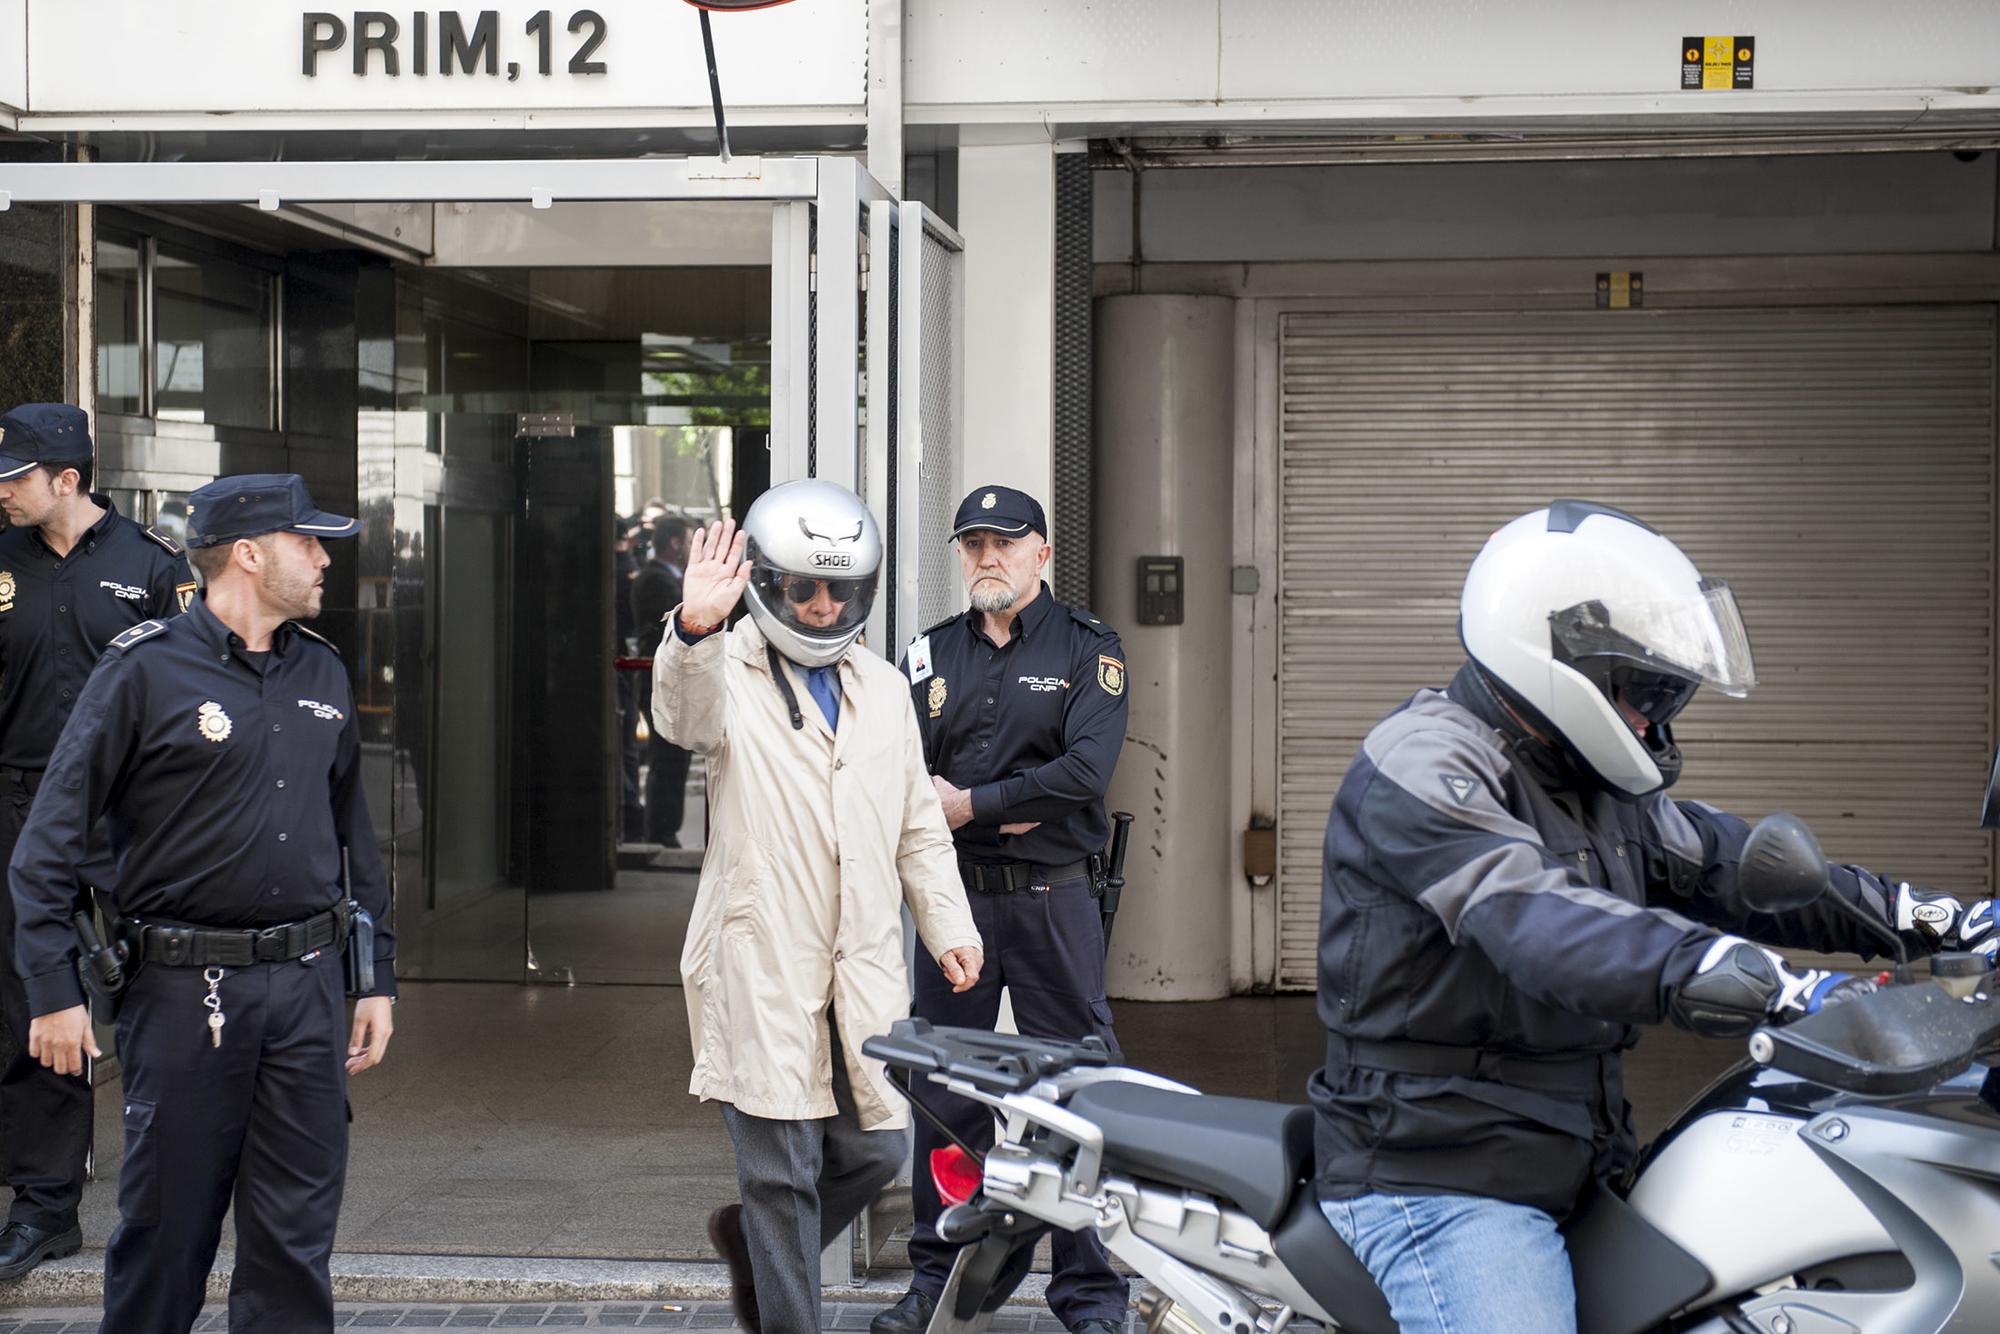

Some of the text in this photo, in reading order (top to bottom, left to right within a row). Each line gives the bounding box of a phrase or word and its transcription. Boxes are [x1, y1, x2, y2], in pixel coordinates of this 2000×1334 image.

[302, 9, 607, 81] PRIM,12
[815, 554, 850, 567] SHOEI
[115, 590, 140, 600] CNP
[1018, 676, 1066, 689] POLICIA
[1030, 684, 1057, 692] CNP
